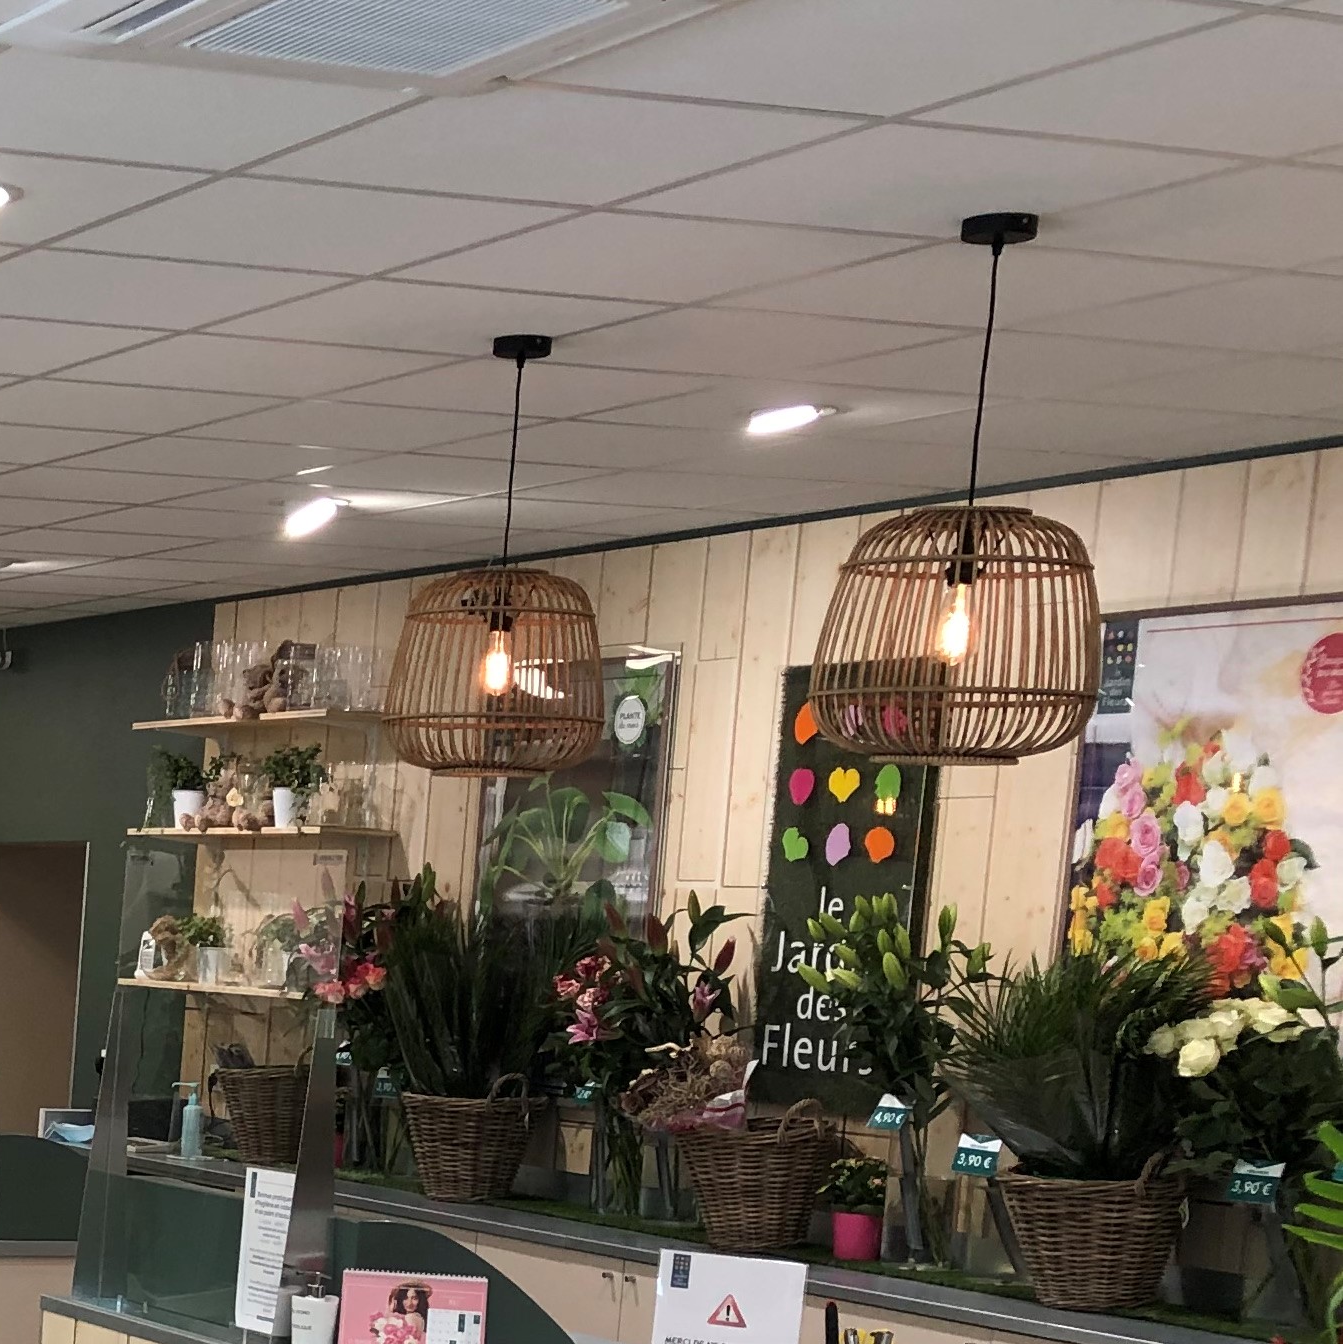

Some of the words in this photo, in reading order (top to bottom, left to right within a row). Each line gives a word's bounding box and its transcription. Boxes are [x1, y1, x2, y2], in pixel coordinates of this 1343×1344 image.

[796, 985, 847, 1022] des
[874, 1111, 896, 1124] 4,90
[895, 1113, 905, 1124] €
[956, 1152, 982, 1167] 3,90
[983, 1156, 993, 1169] €
